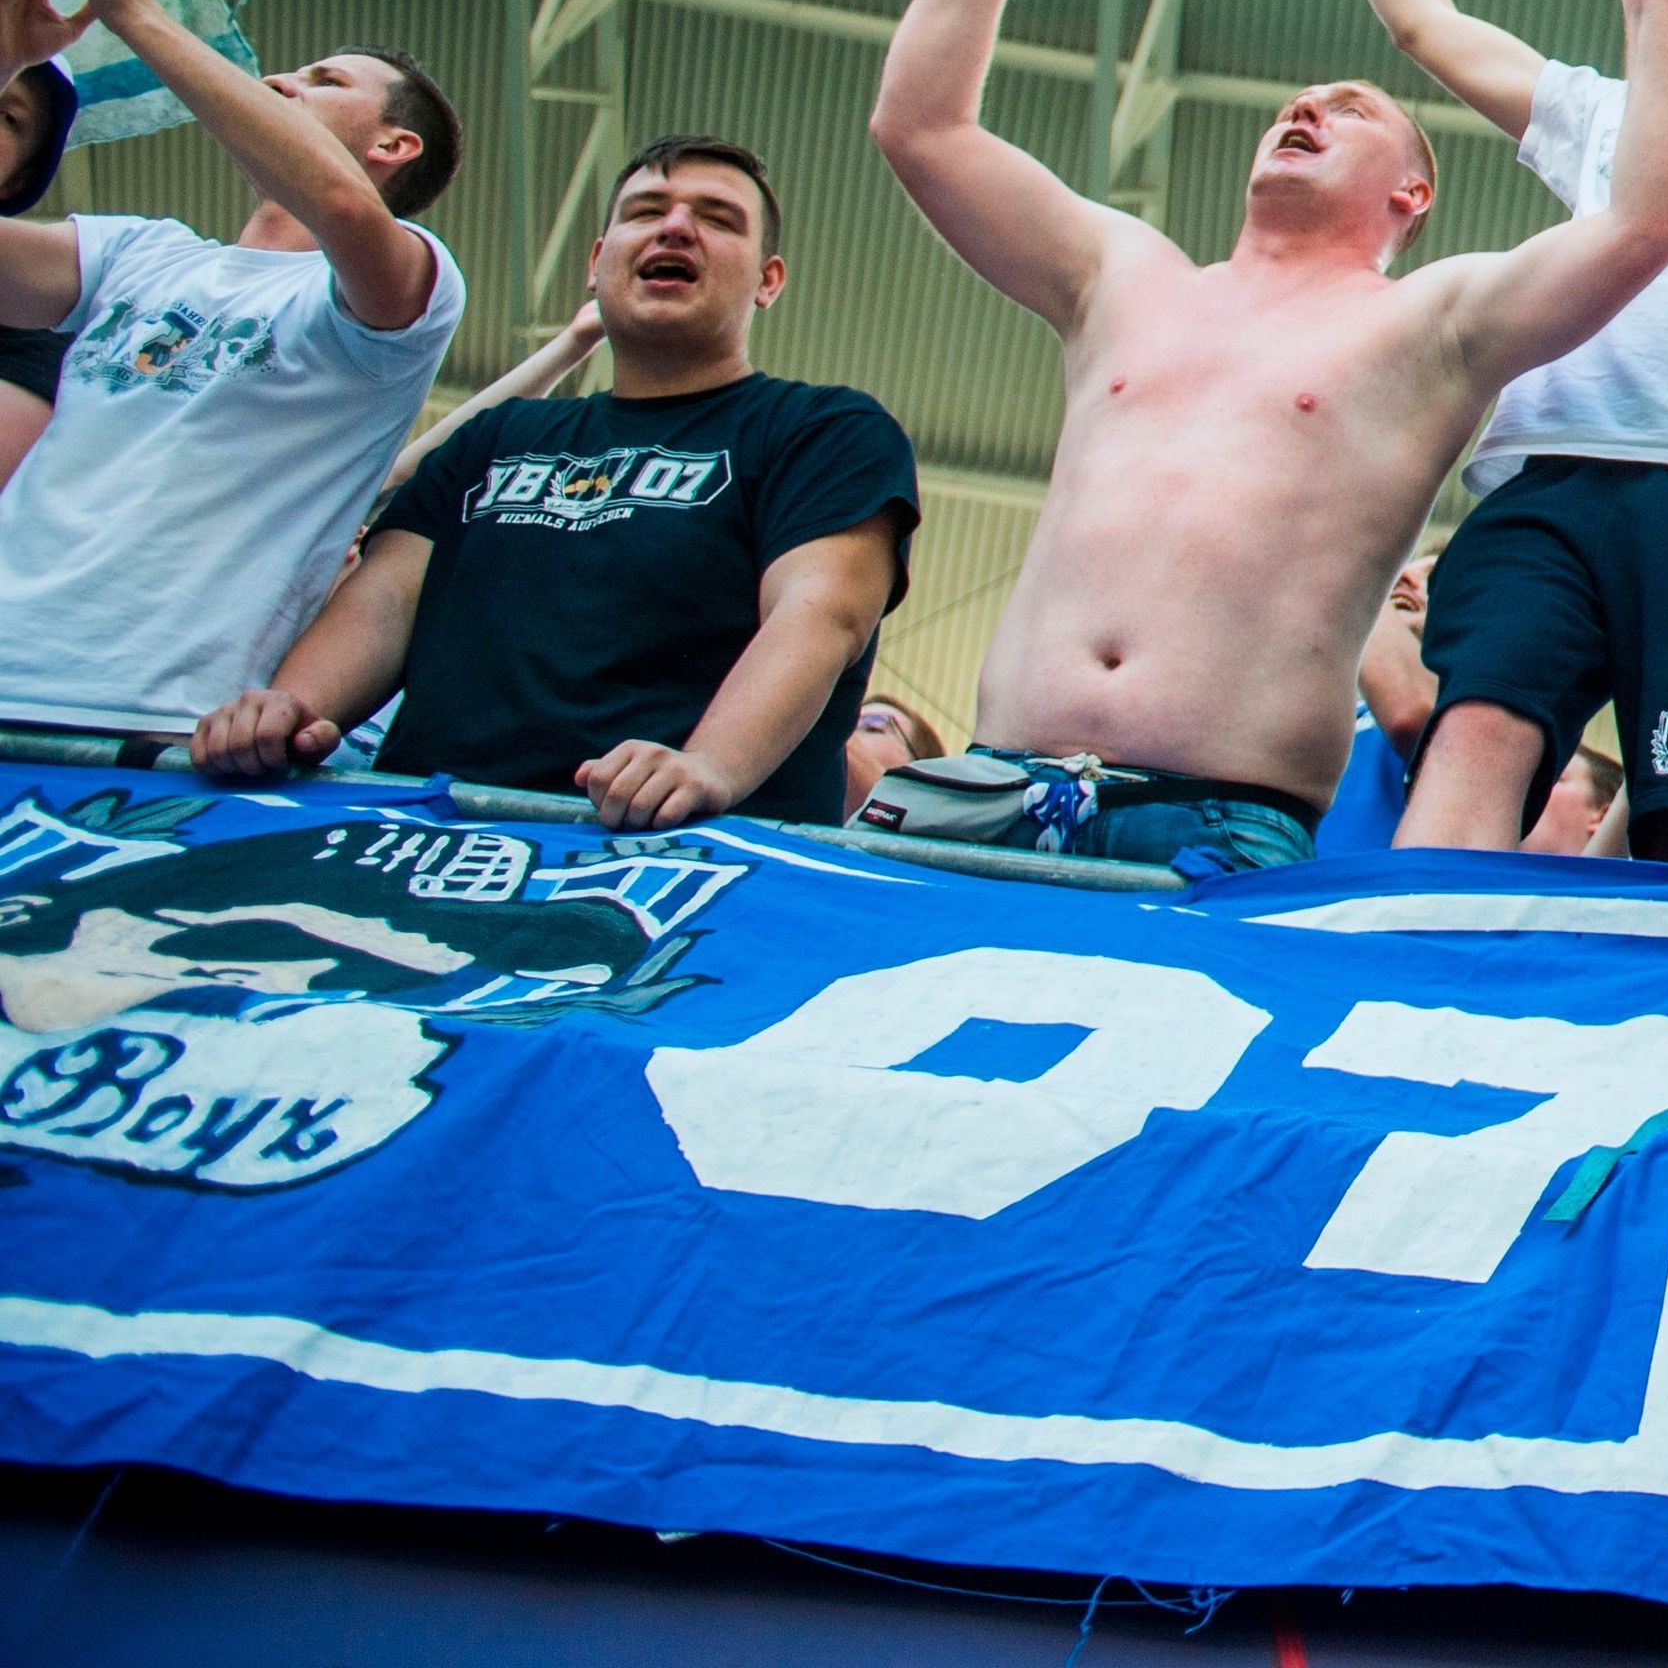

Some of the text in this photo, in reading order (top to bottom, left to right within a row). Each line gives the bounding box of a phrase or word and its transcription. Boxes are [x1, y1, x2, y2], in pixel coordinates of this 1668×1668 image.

[172, 300, 208, 328] JAHR
[474, 457, 718, 510] YB 07
[496, 512, 567, 529] NIEMALS
